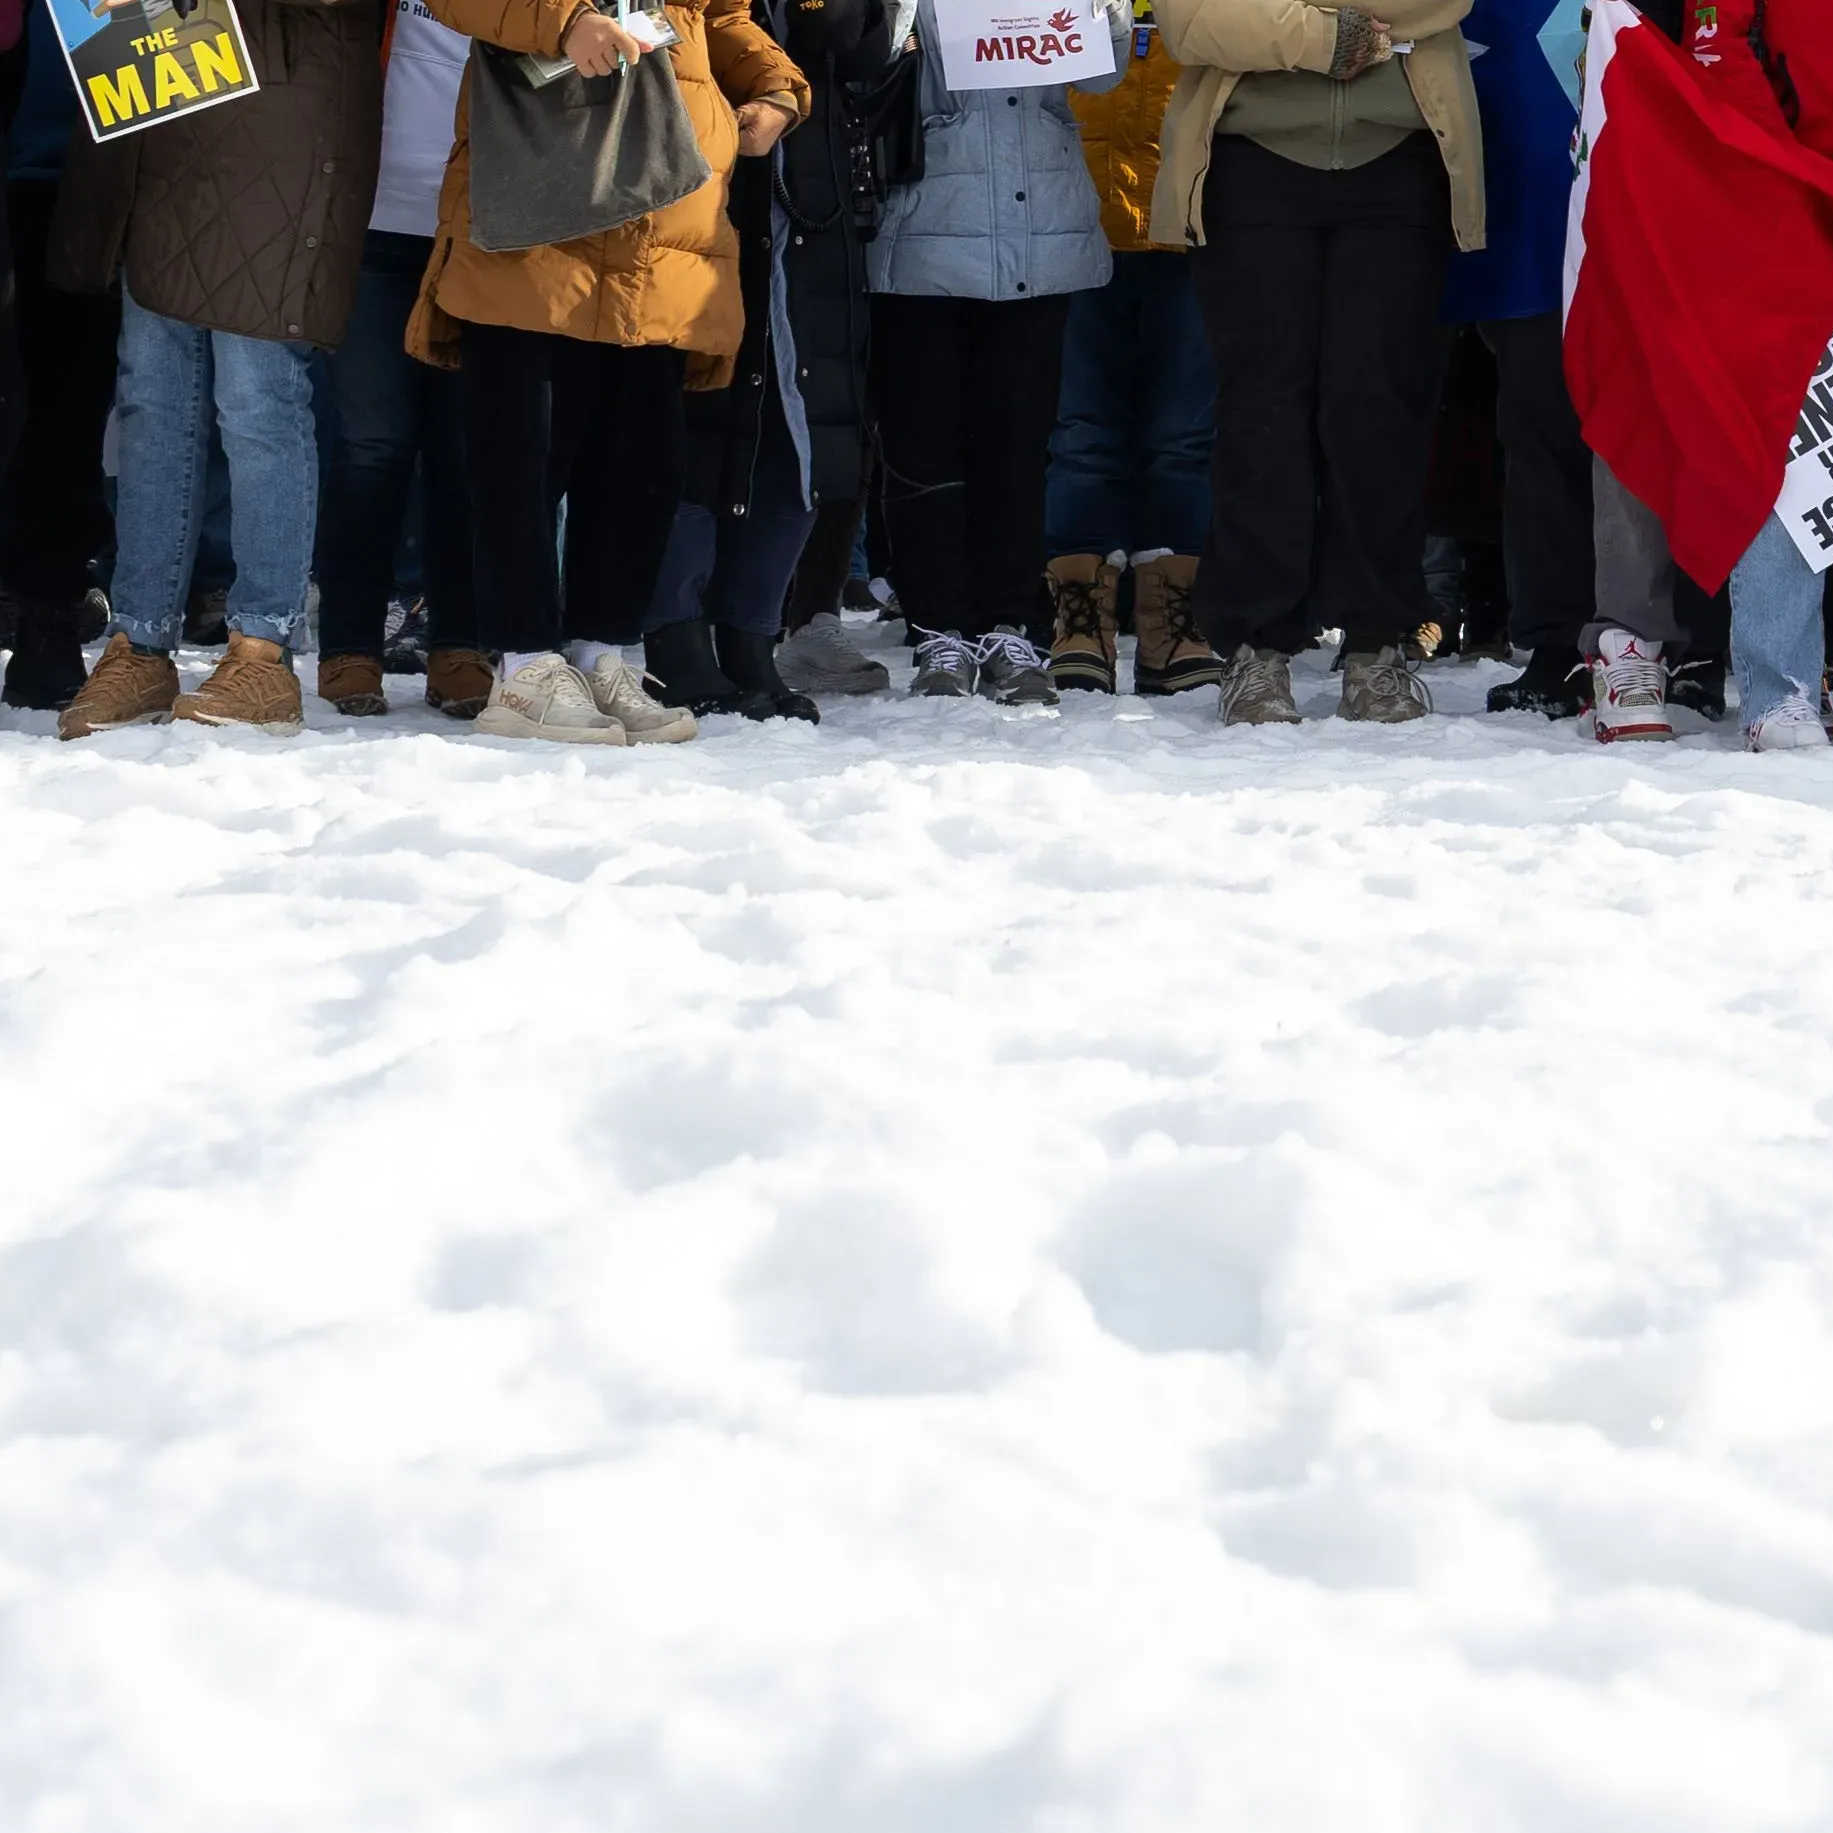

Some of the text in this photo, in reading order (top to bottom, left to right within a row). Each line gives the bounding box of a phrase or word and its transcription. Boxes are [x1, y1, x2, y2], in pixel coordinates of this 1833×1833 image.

[799, 0, 824, 10] TOKO
[130, 28, 178, 56] THE
[975, 34, 1083, 65] MIRAC
[87, 32, 243, 127] MAN
